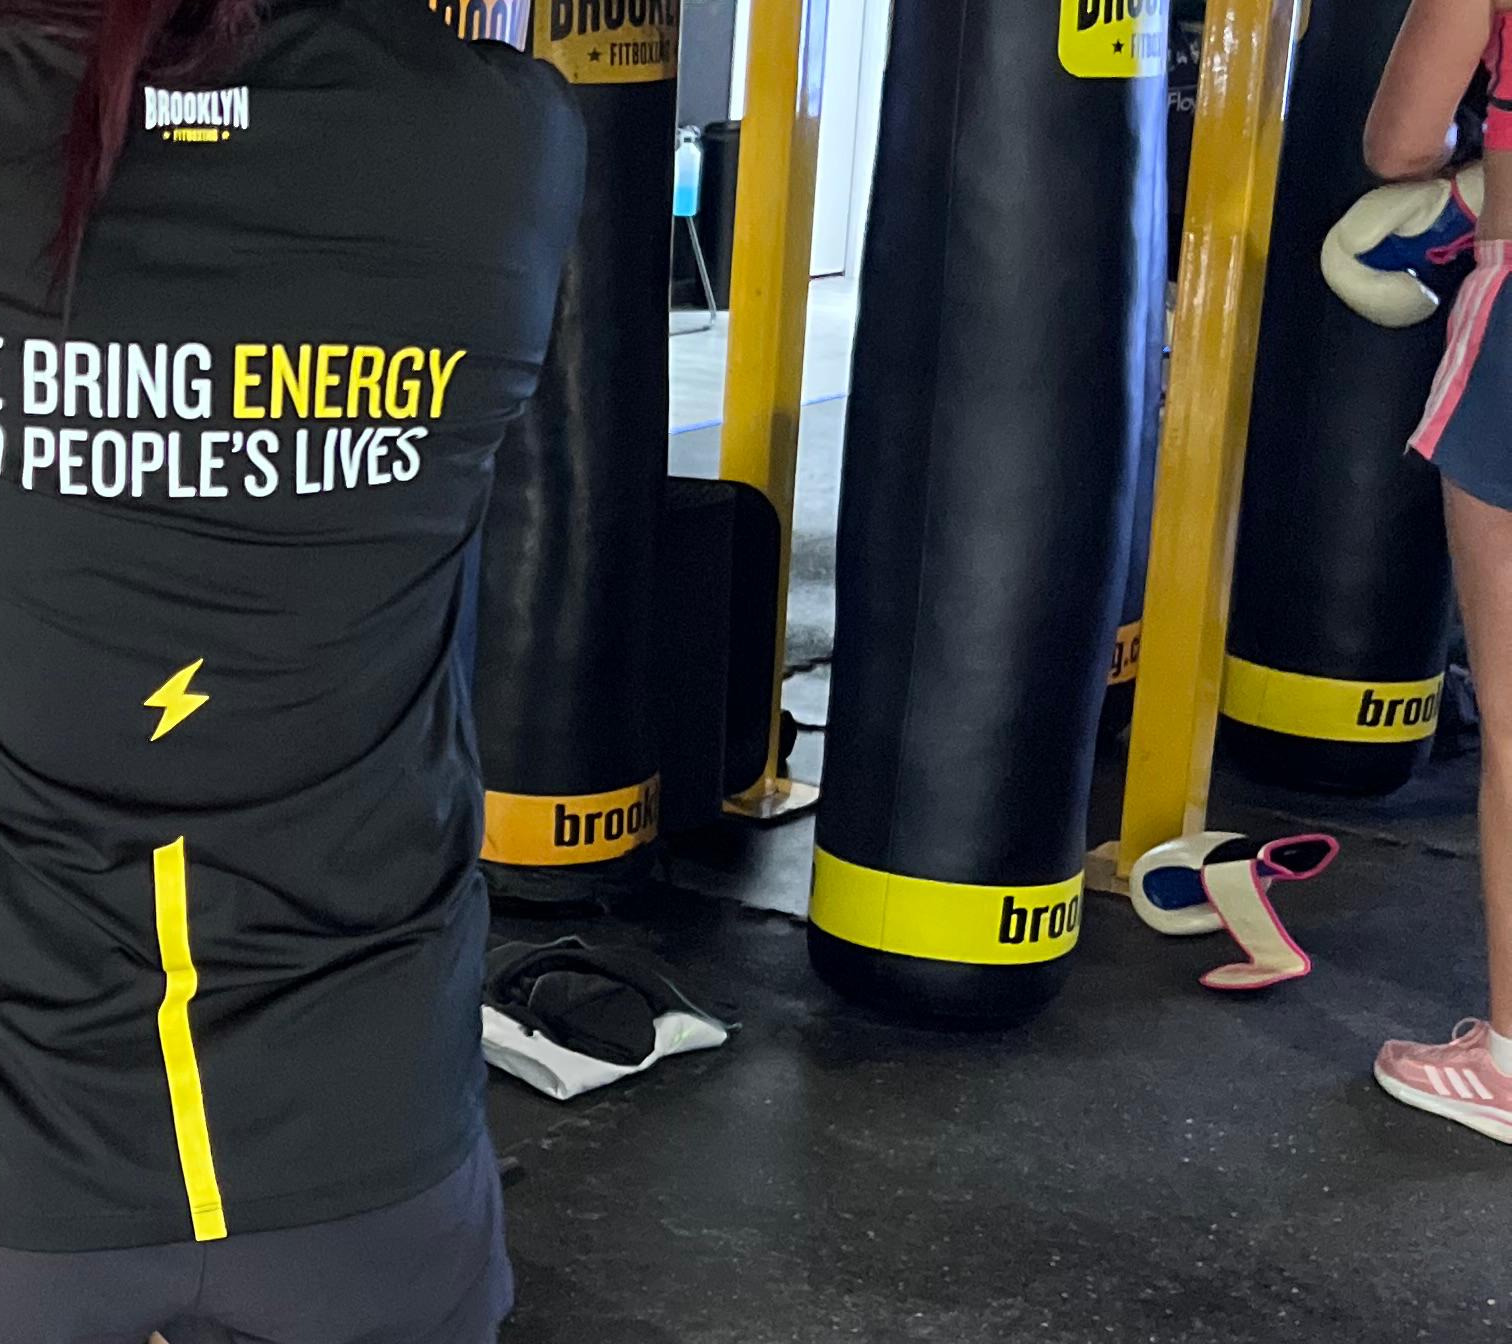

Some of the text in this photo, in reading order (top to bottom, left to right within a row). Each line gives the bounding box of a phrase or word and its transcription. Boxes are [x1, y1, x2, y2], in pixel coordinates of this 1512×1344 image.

[144, 86, 249, 130] BROOKLYN
[22, 339, 212, 420] BRING
[232, 343, 468, 420] ENERGY
[21, 428, 279, 498] PEOPLE'S
[295, 425, 429, 495] LIVES
